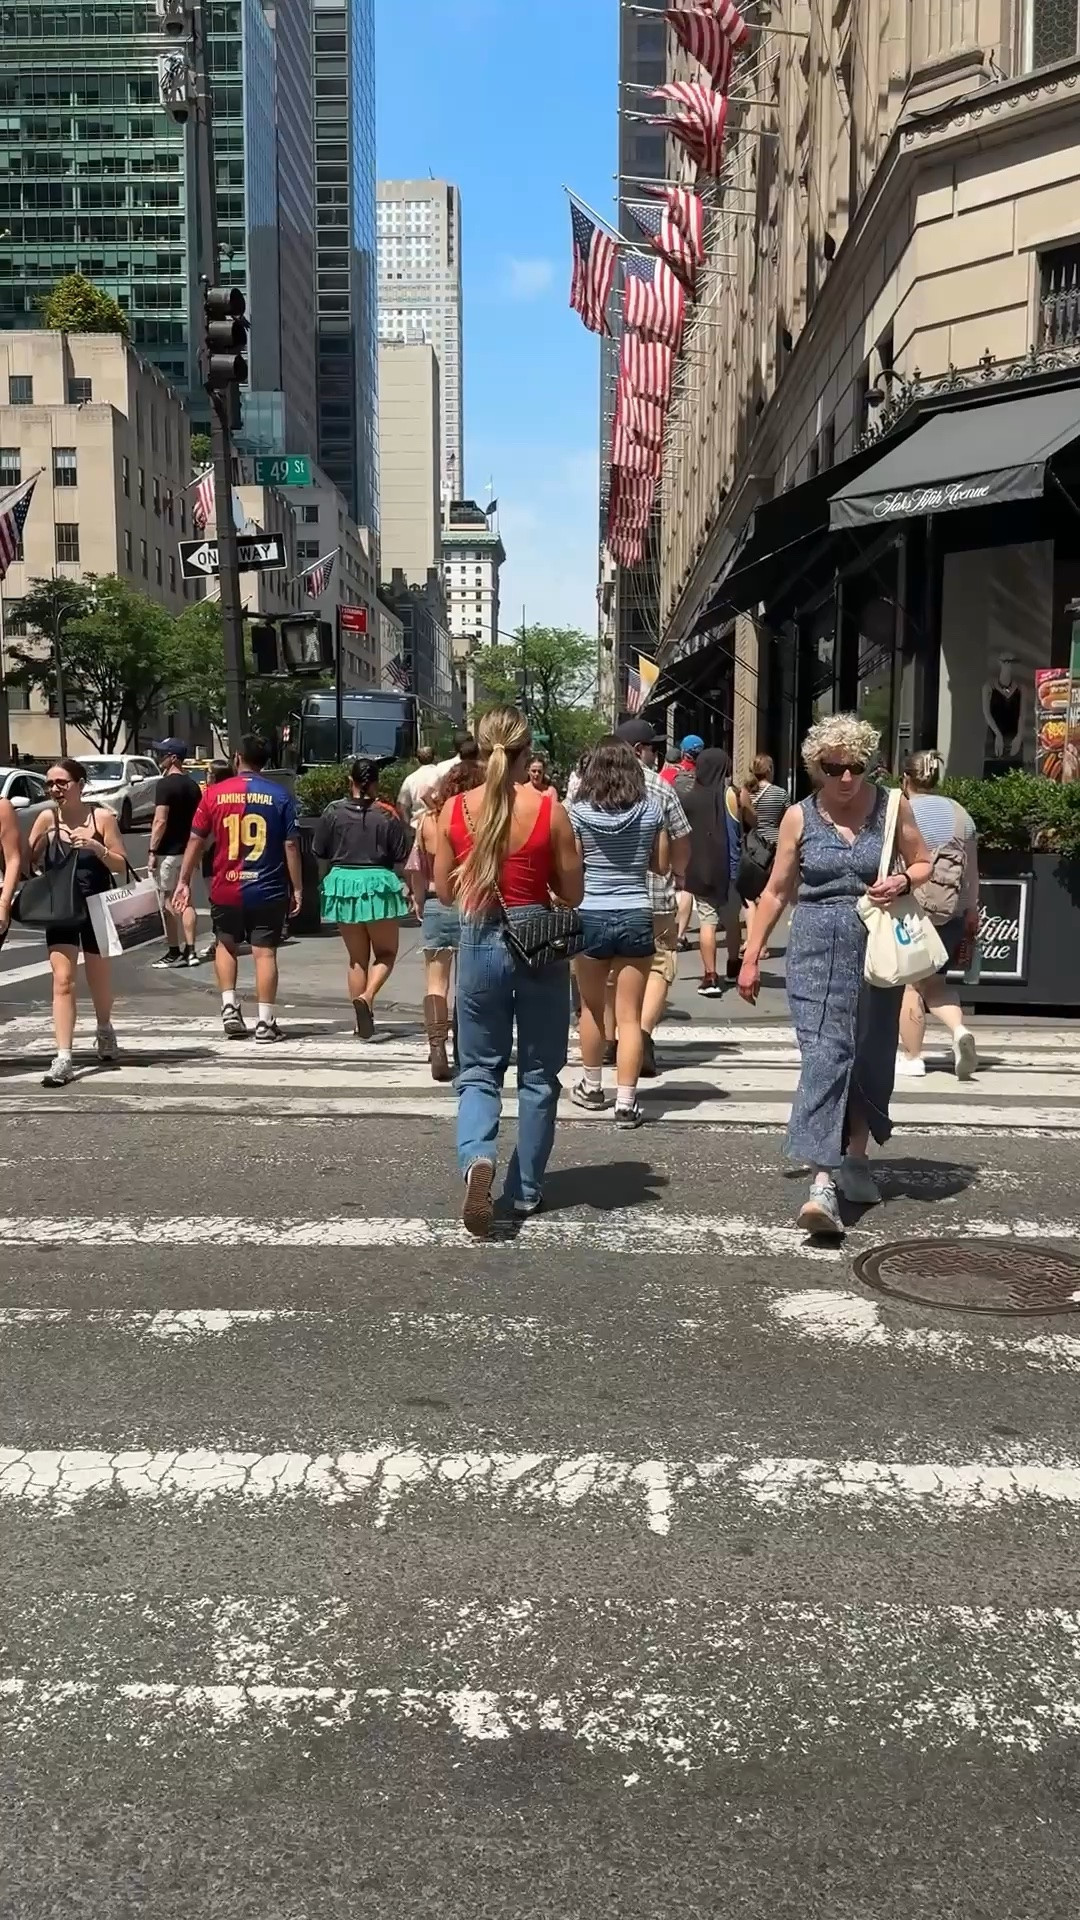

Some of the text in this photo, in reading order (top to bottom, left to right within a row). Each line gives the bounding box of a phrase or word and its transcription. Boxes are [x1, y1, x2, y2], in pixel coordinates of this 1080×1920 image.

[256, 460, 304, 481] E 49 St
[873, 483, 990, 517] Saks Fifth Avenue
[239, 545, 270, 560] WAY
[247, 793, 273, 805] YAMAL
[222, 813, 267, 861] 19
